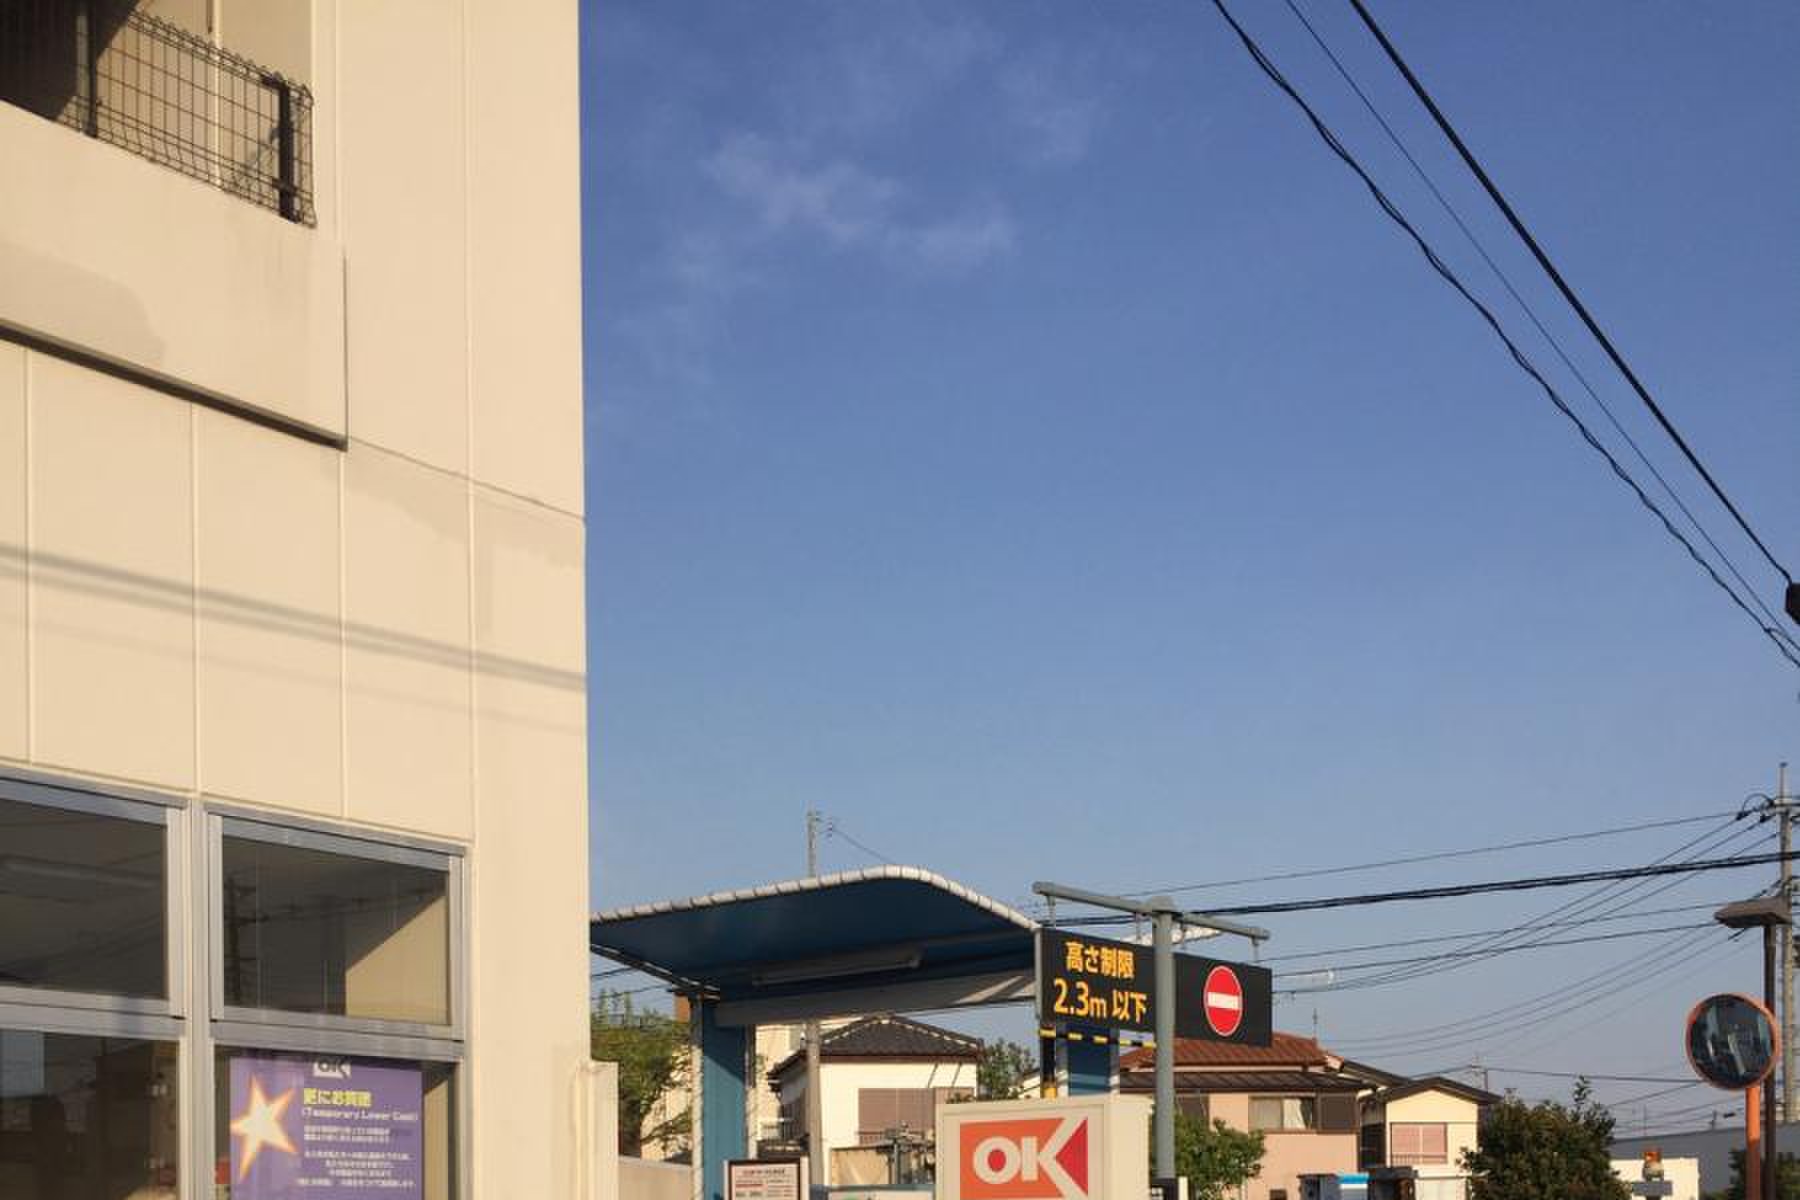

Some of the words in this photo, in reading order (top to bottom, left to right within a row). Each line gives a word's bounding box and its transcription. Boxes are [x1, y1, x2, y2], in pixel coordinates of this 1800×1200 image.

[1064, 939, 1136, 979] 高さ制限
[971, 1117, 1089, 1200] OK
